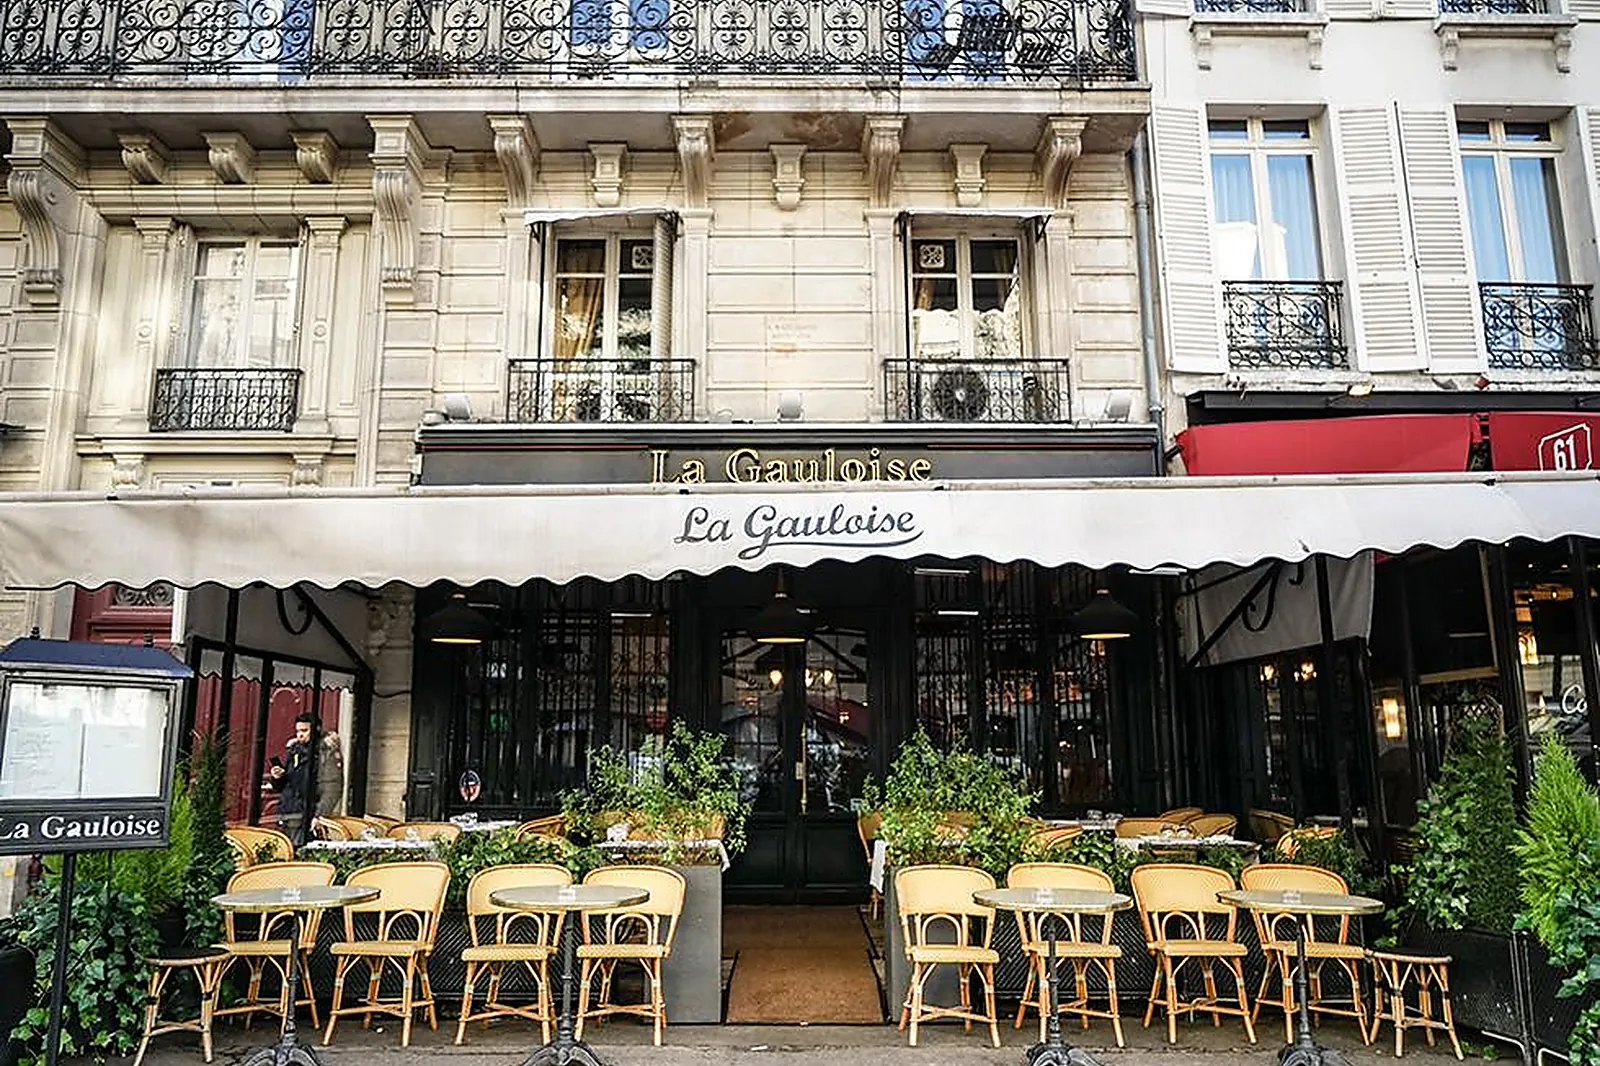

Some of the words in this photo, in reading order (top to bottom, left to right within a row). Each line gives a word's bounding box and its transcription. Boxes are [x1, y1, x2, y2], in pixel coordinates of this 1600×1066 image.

[651, 449, 706, 483] La
[725, 447, 931, 483] Gauloise
[1553, 434, 1576, 471] 61
[673, 506, 734, 543] La
[737, 503, 924, 560] Gauloise
[41, 815, 160, 839] Gauloise
